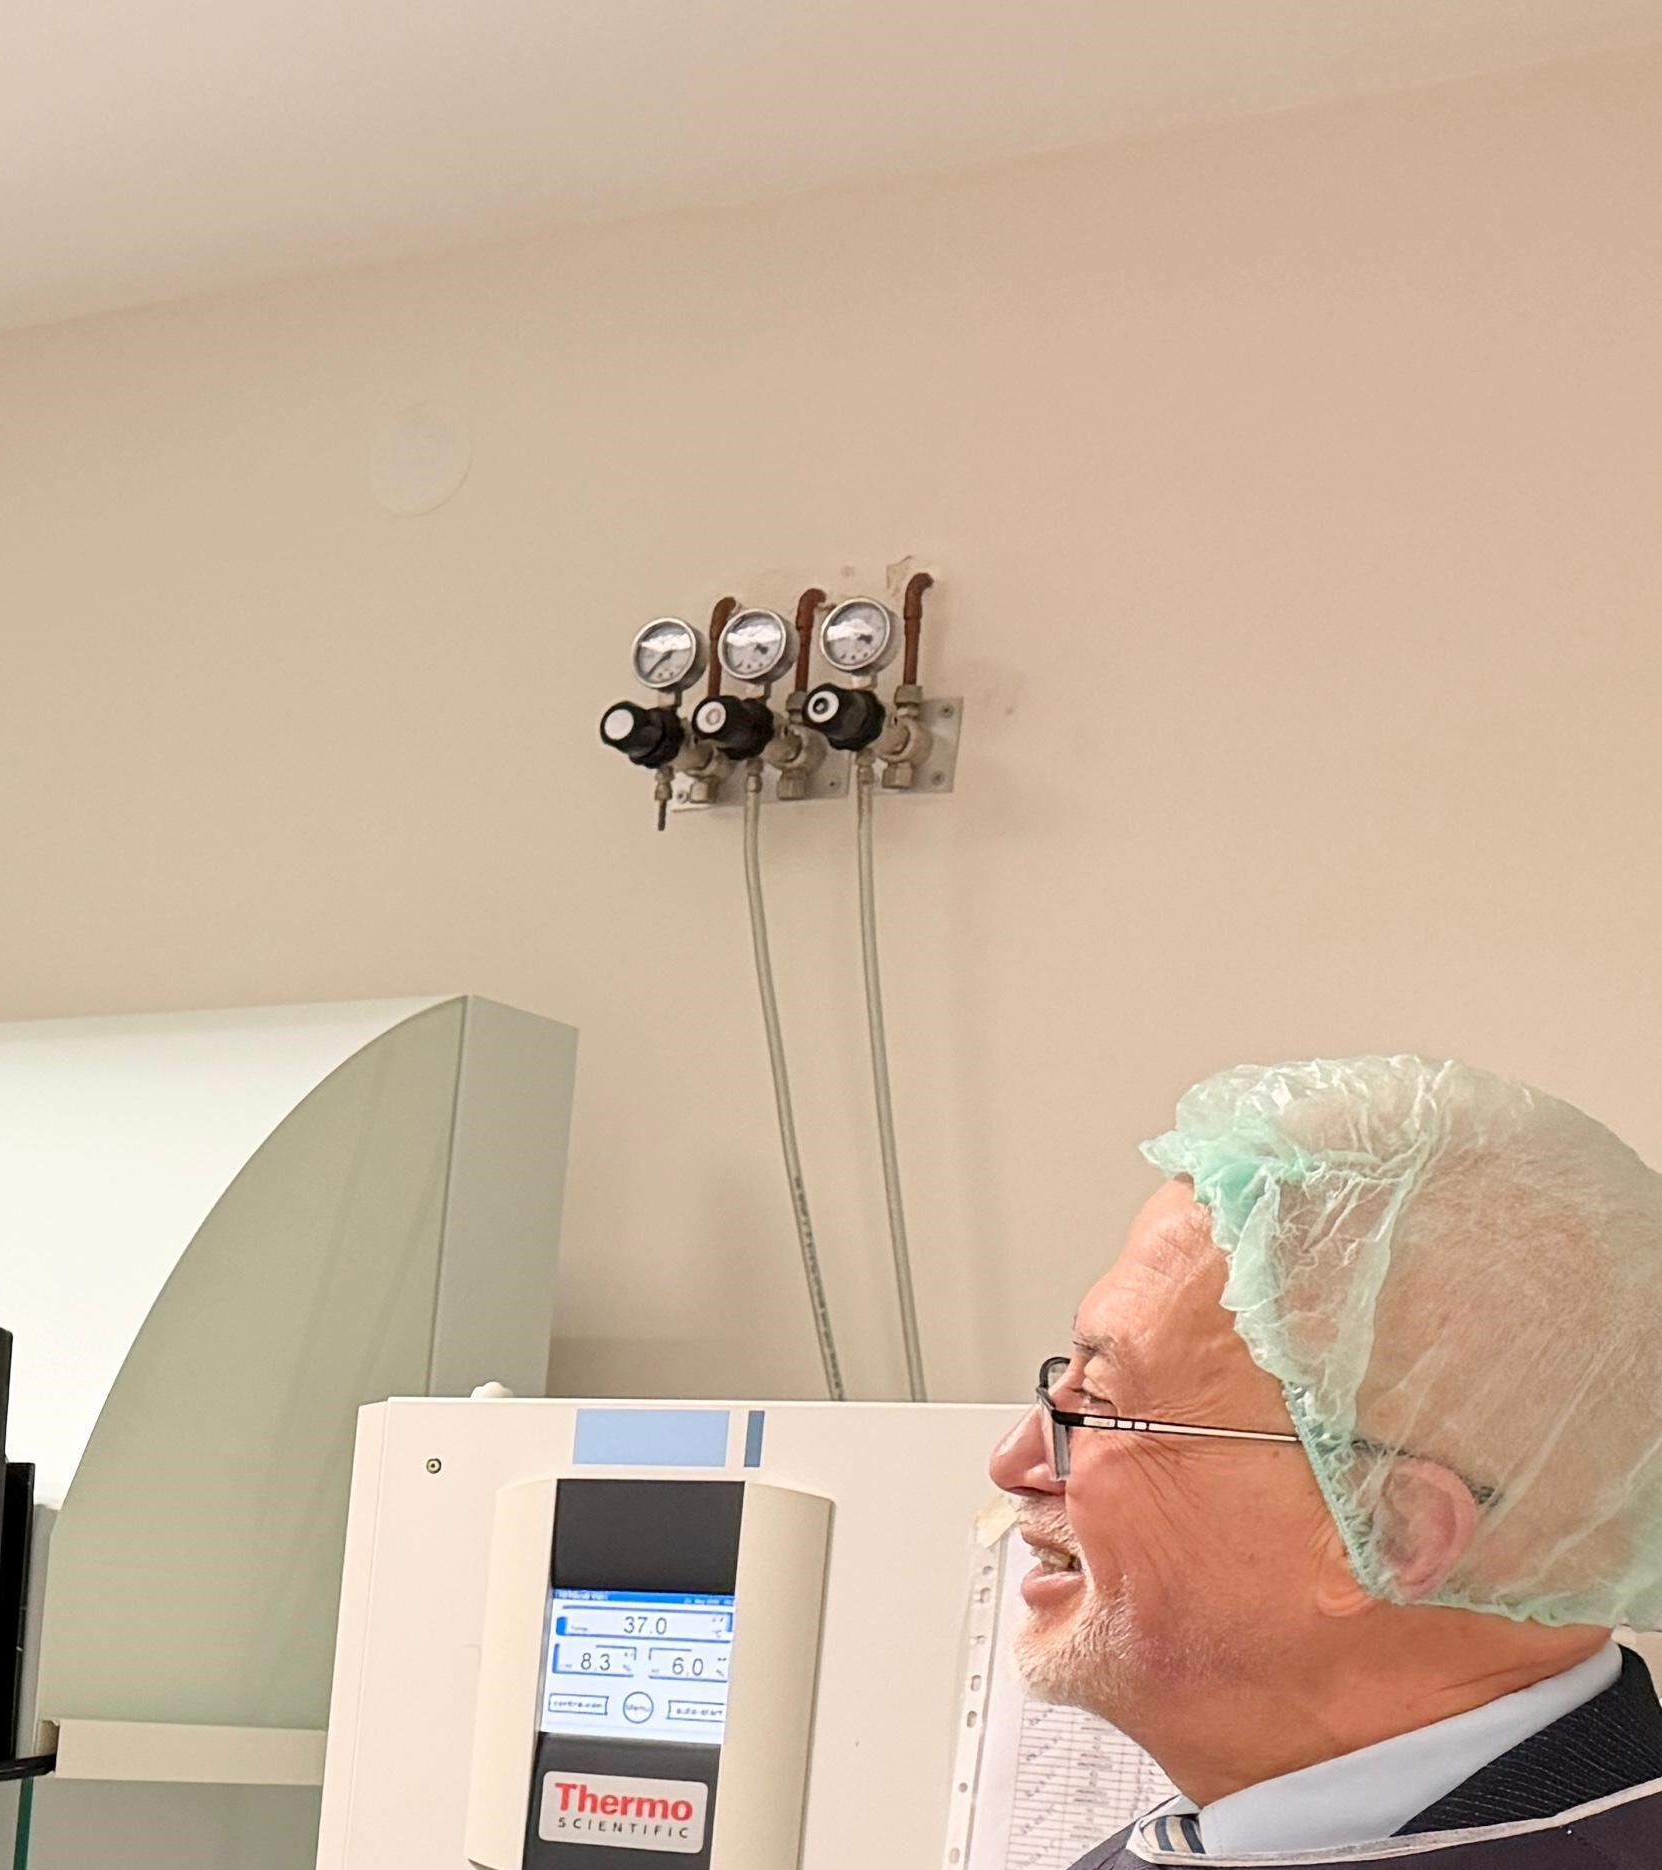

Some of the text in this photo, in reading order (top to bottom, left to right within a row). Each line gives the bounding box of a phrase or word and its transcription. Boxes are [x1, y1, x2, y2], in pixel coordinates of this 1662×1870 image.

[623, 1616, 668, 1635] 37.0
[580, 1652, 611, 1671] 8.3
[672, 1657, 704, 1676] 6.0
[554, 1782, 693, 1821] Thermo
[558, 1817, 689, 1838] SCIENTIFIC
